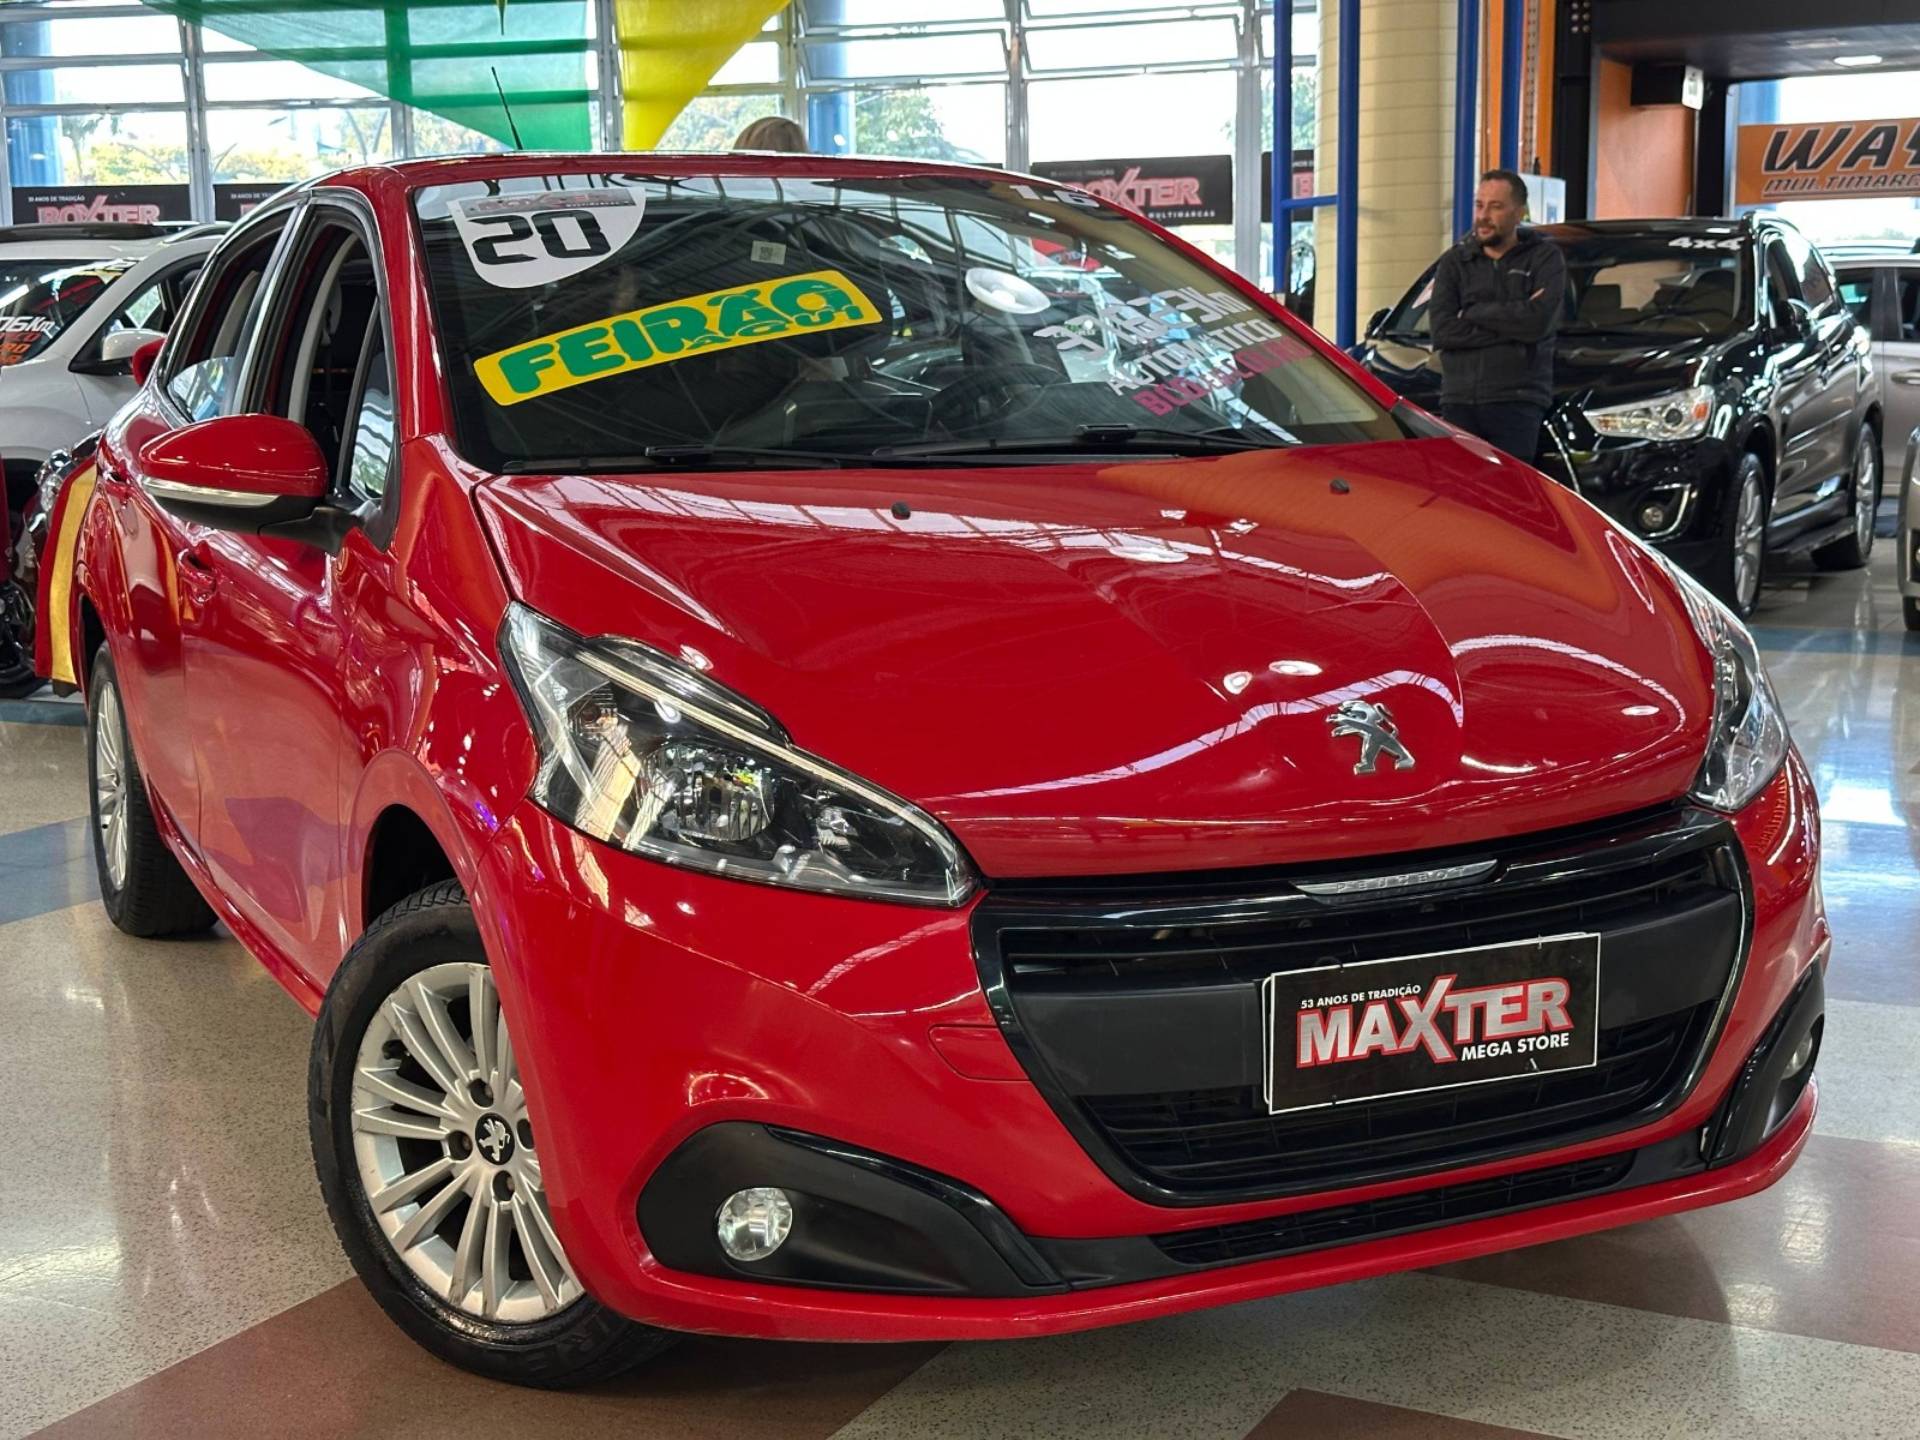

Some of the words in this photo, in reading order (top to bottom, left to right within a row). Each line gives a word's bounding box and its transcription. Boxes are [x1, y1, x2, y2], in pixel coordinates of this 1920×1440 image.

[1009, 184, 1100, 207] 1.6
[467, 209, 612, 266] 20
[1668, 236, 1745, 251] 4x4
[497, 278, 854, 394] FEIRÃO
[1105, 318, 1282, 396] AUTOMÁTICO
[1336, 866, 1467, 893] PEUGEOT
[1300, 999, 1314, 1010] 53
[1316, 994, 1349, 1008] ANOS
[1351, 992, 1366, 1002] DE
[1367, 984, 1422, 1001] TRADIÇÃO
[1296, 973, 1574, 1068] MAXTER
[1461, 1041, 1513, 1062] MEGA
[1516, 1033, 1570, 1052] STORE
